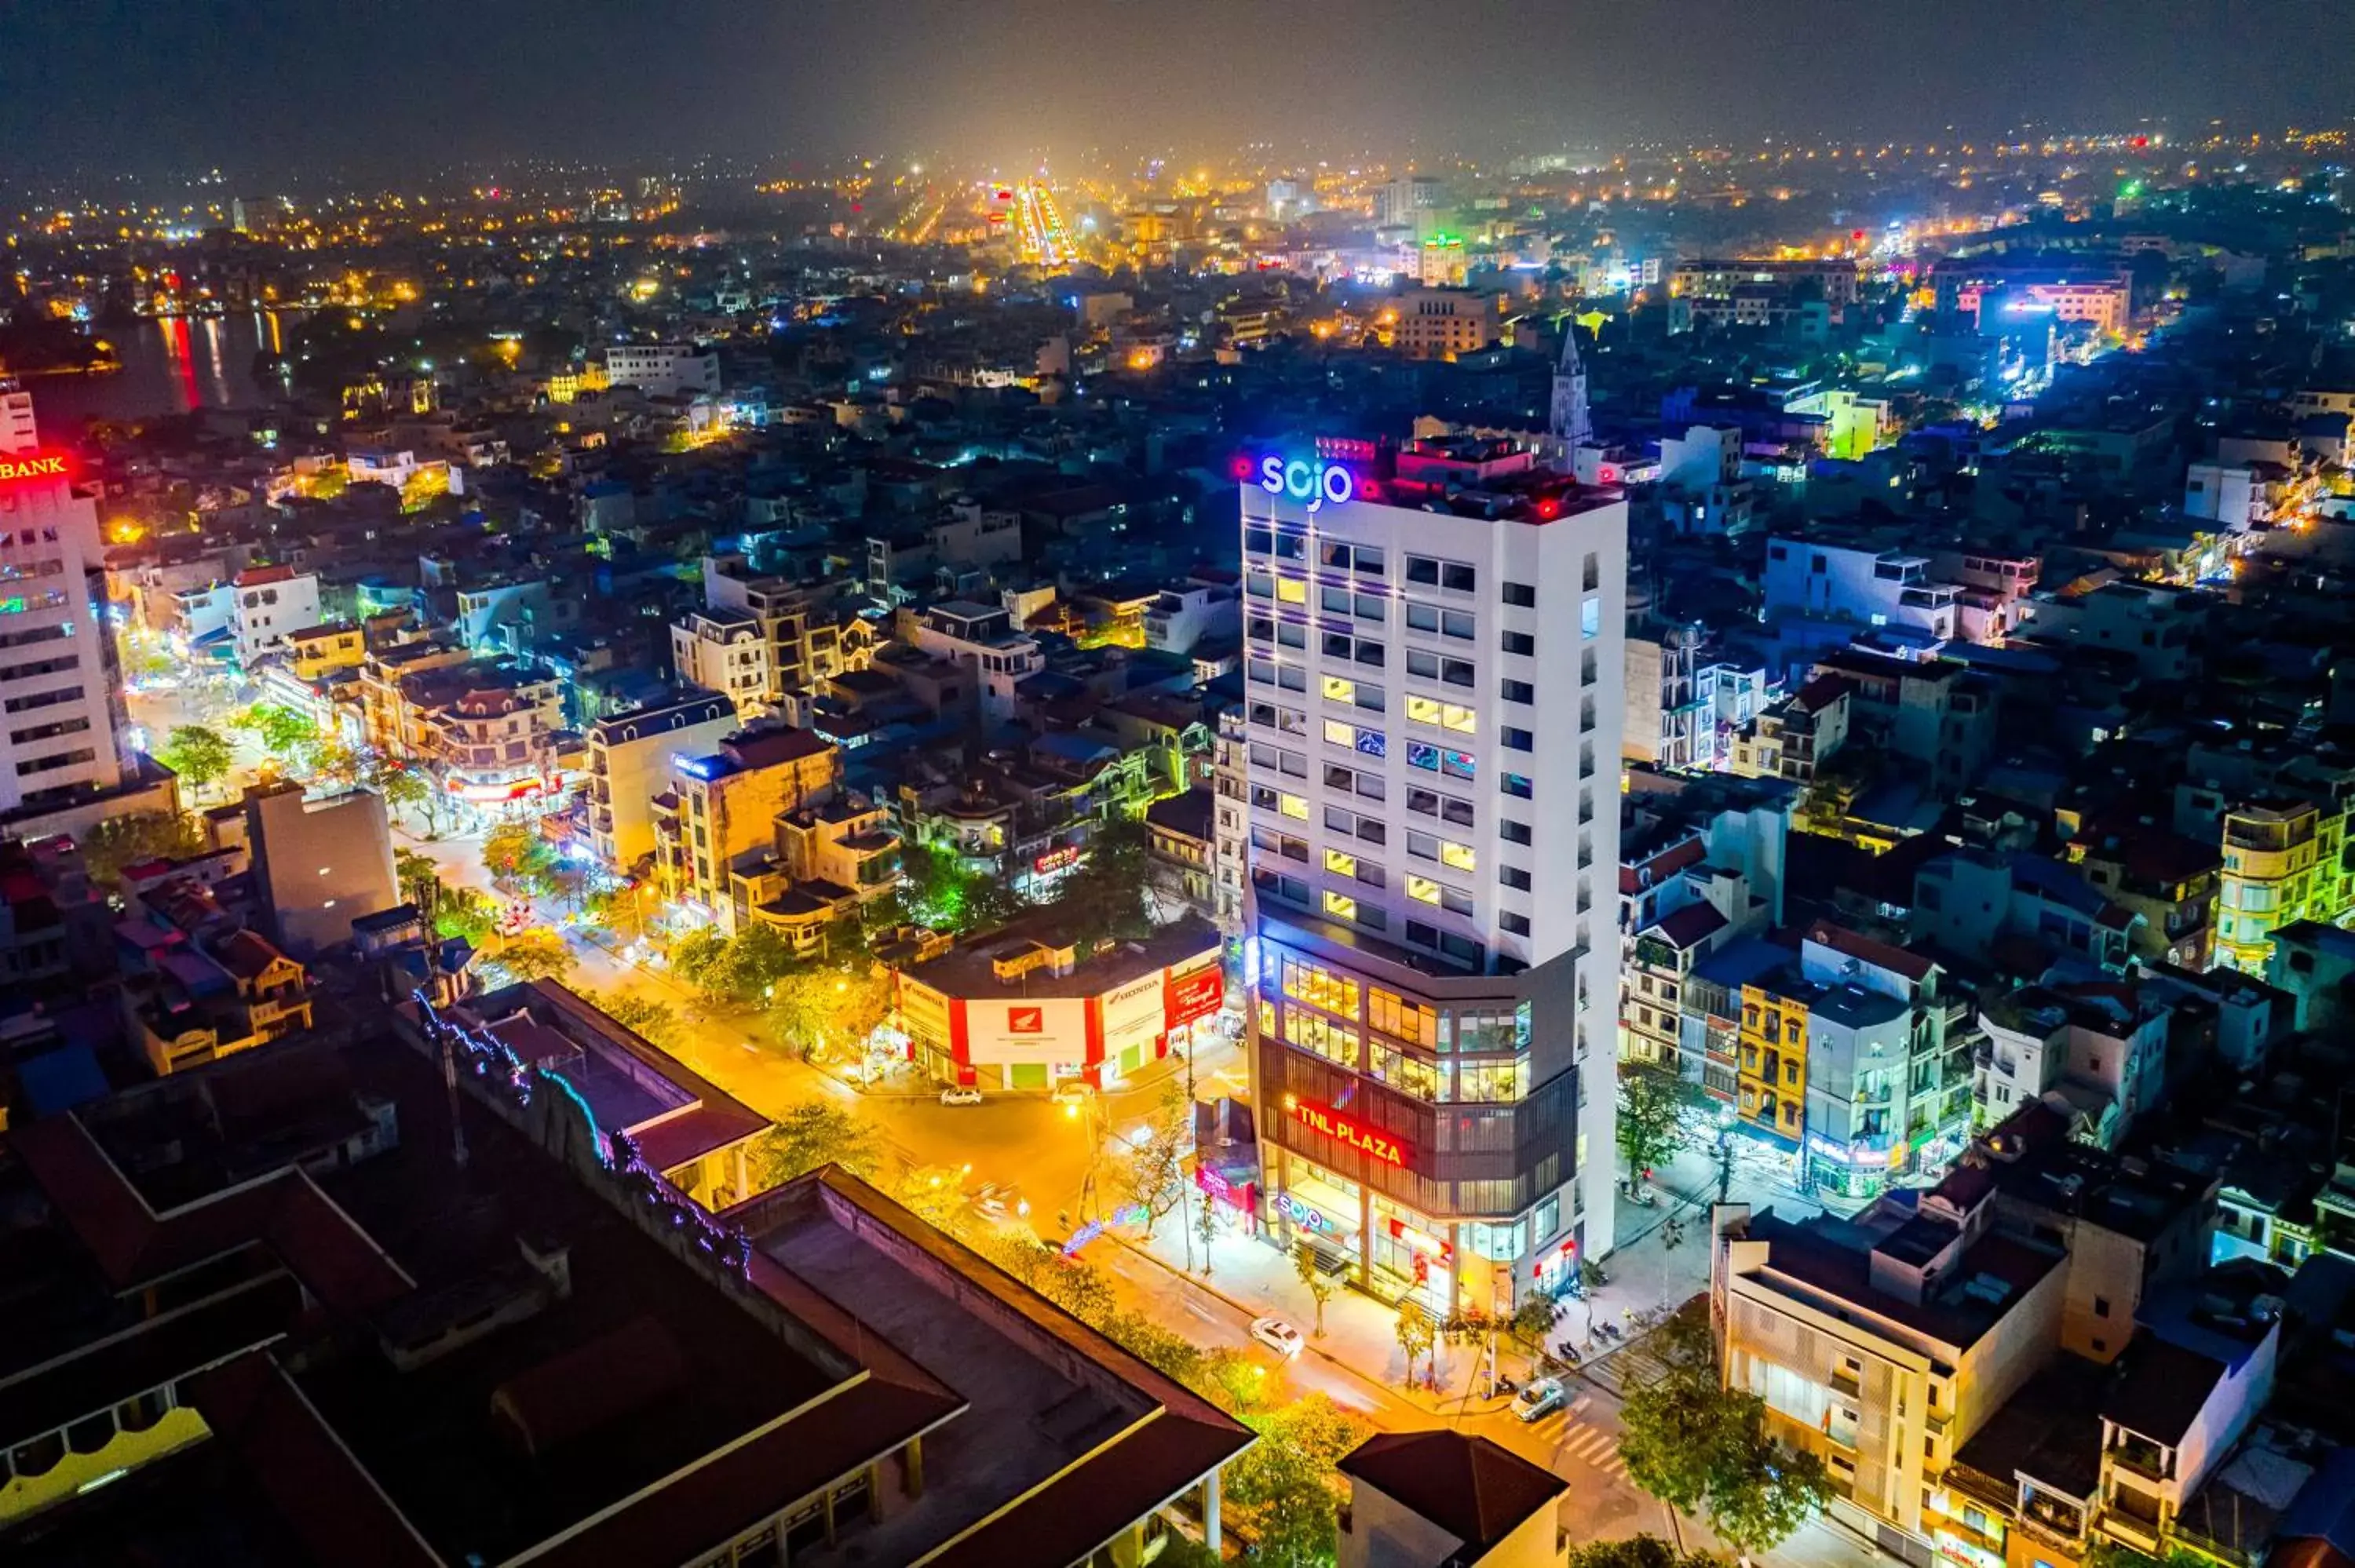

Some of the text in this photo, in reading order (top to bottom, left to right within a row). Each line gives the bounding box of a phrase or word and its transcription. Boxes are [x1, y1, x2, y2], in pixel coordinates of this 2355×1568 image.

[0, 458, 67, 479] BANK
[1298, 1105, 1401, 1165] TNL PLAZA
